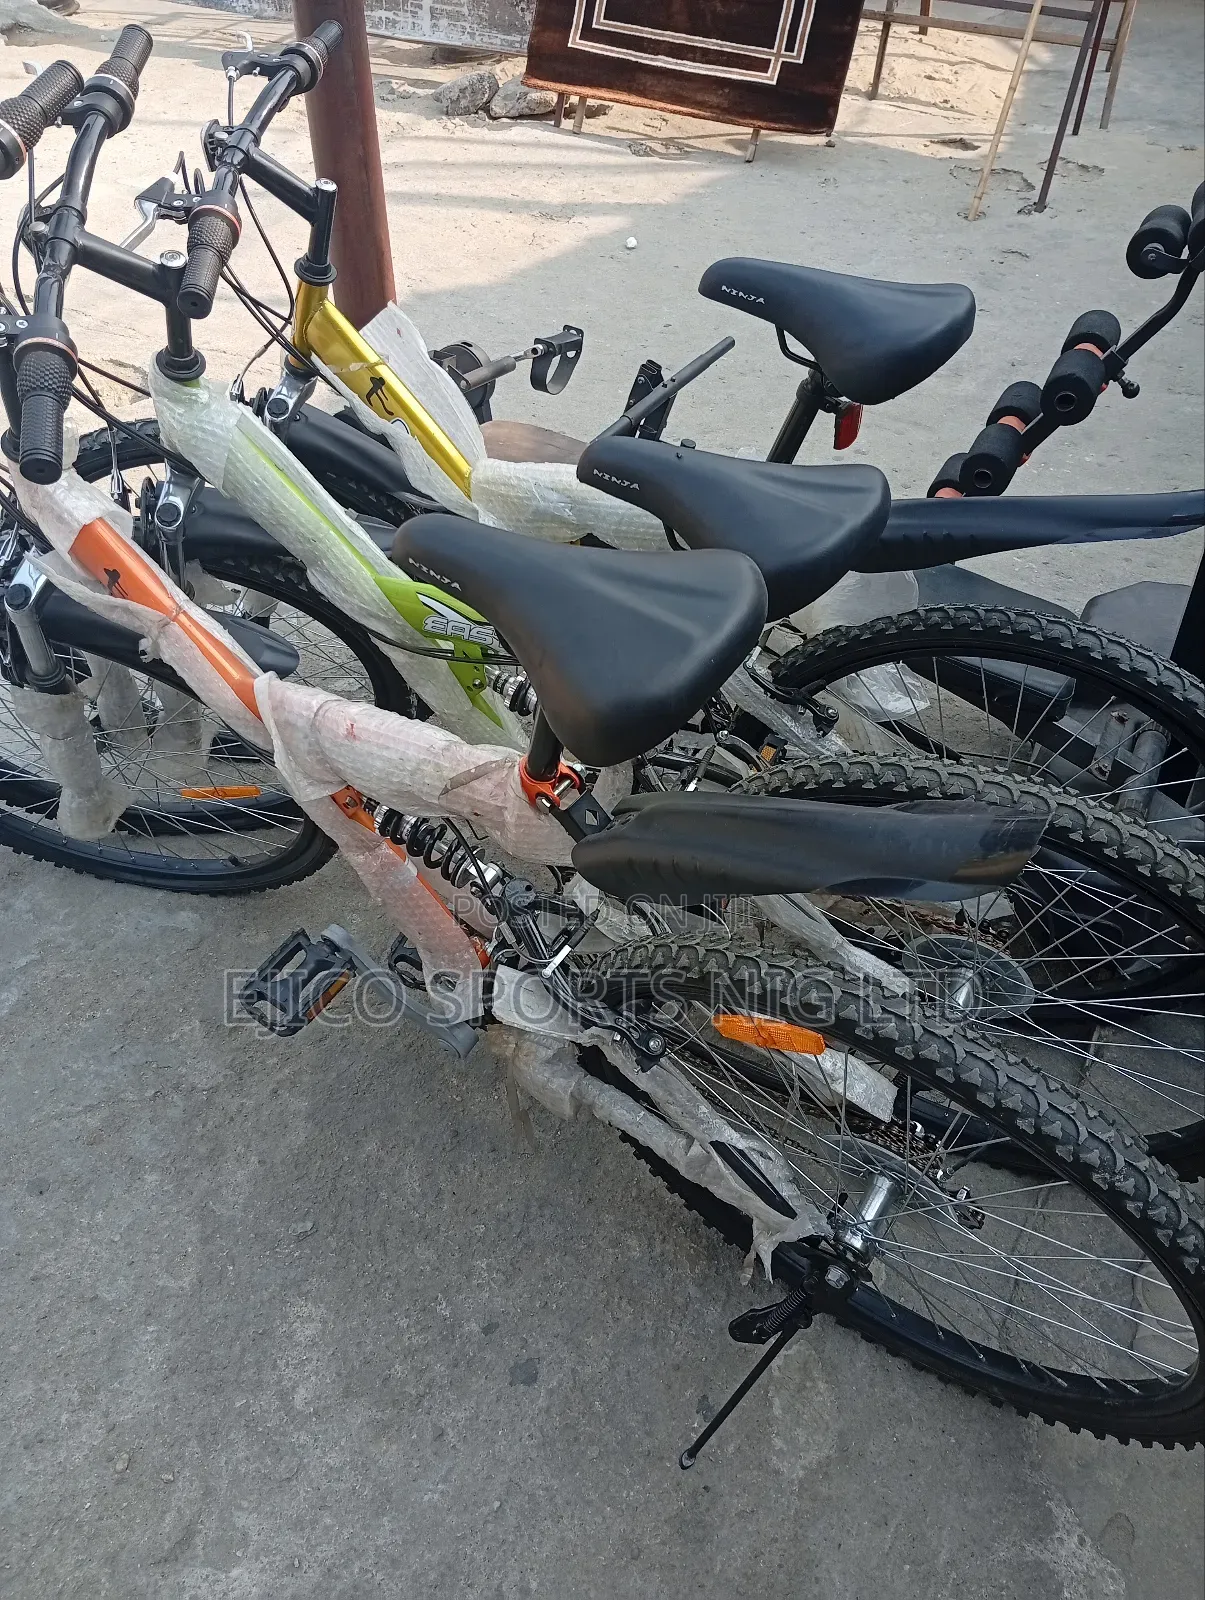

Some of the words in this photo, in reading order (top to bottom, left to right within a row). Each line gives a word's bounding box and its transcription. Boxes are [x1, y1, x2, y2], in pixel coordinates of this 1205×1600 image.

[721, 285, 765, 304] NINJA
[593, 468, 640, 491] NINJA
[408, 557, 462, 592] NINJA
[423, 615, 503, 650] EAS
